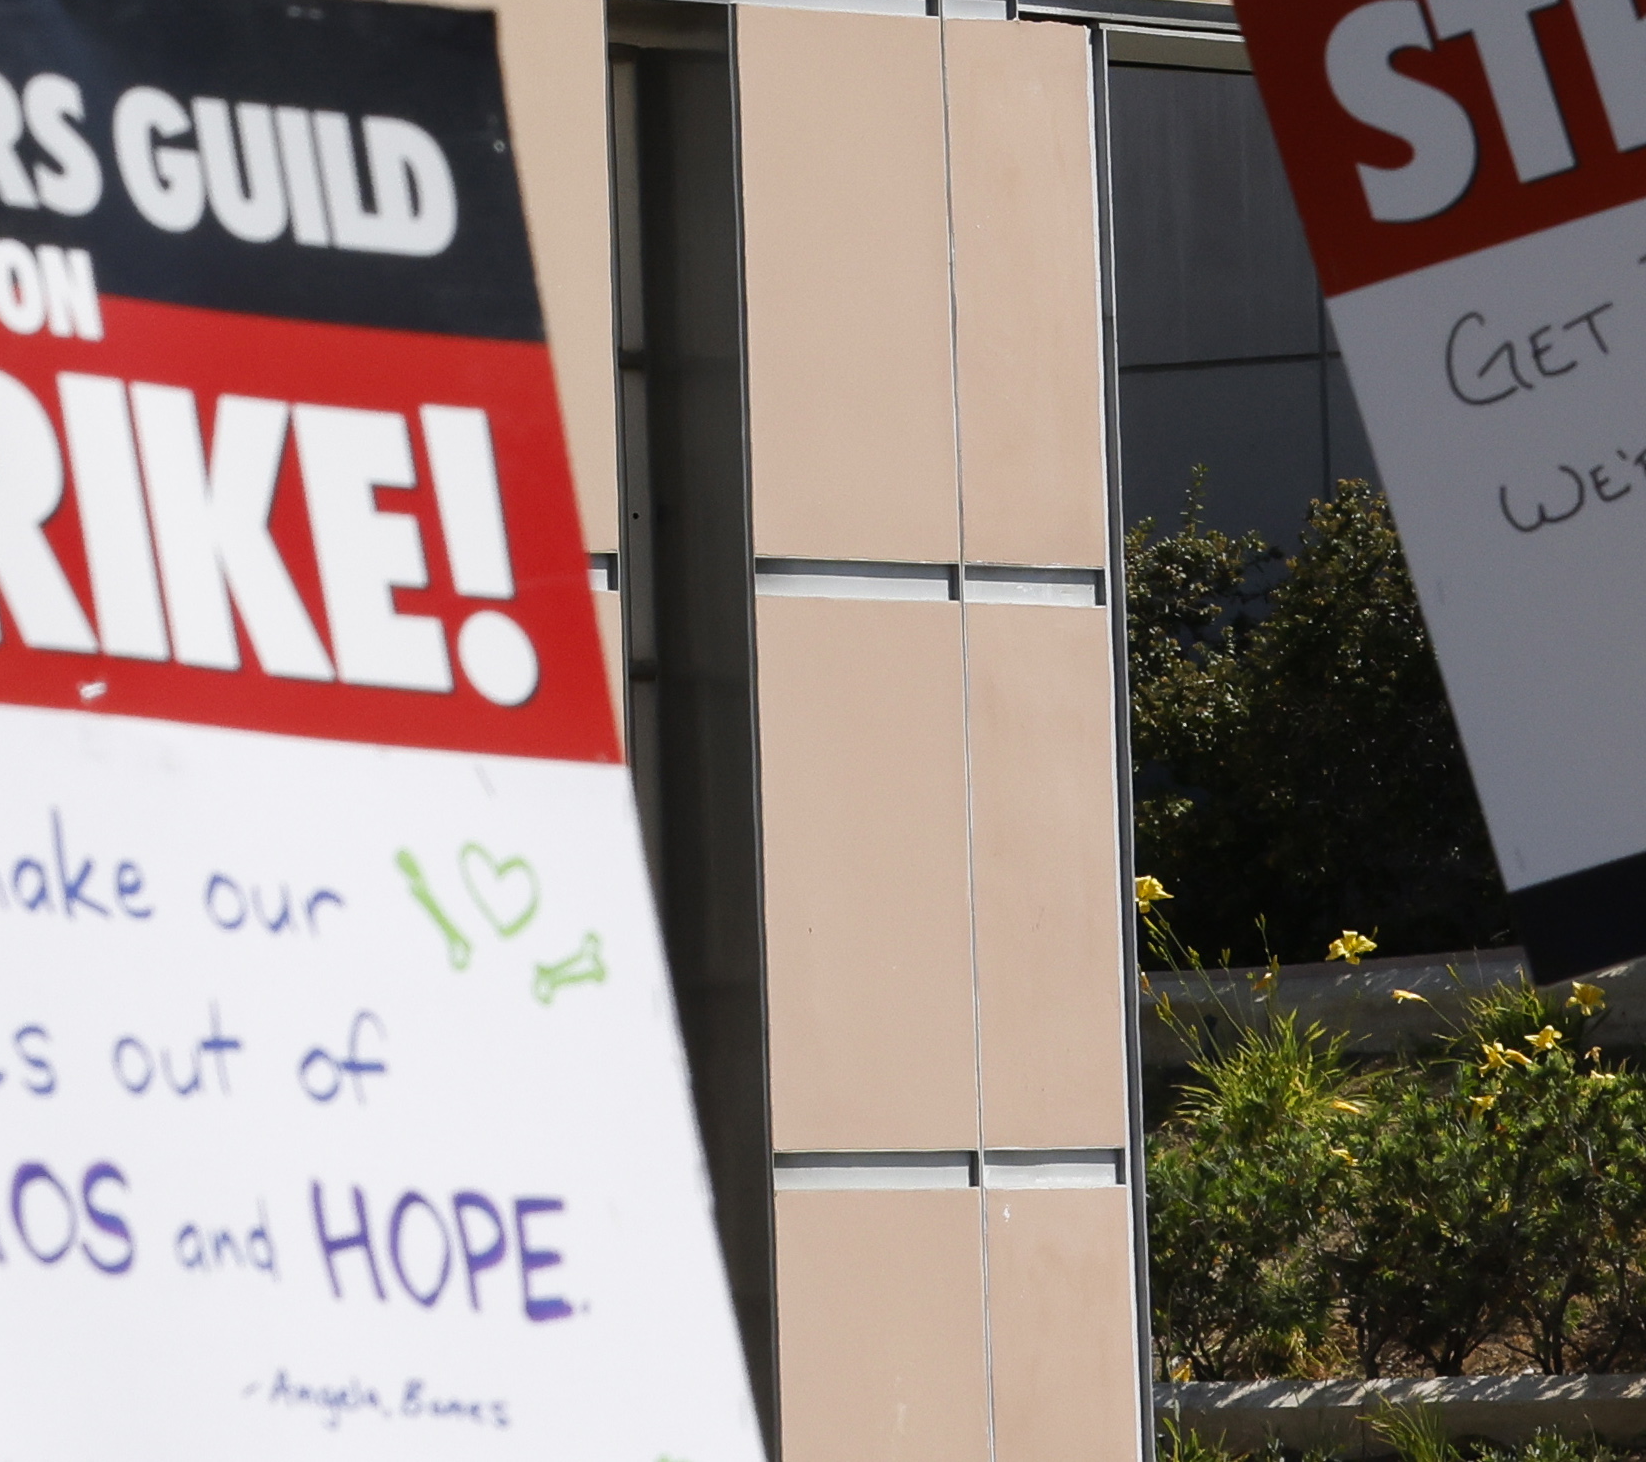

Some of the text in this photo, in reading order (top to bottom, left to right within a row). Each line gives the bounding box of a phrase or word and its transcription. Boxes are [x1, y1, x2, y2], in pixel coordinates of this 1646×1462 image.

[111, 85, 458, 258] GUILD
[205, 870, 344, 937] our
[112, 1000, 242, 1098] out
[299, 1008, 388, 1104] of
[175, 1197, 278, 1275] and
